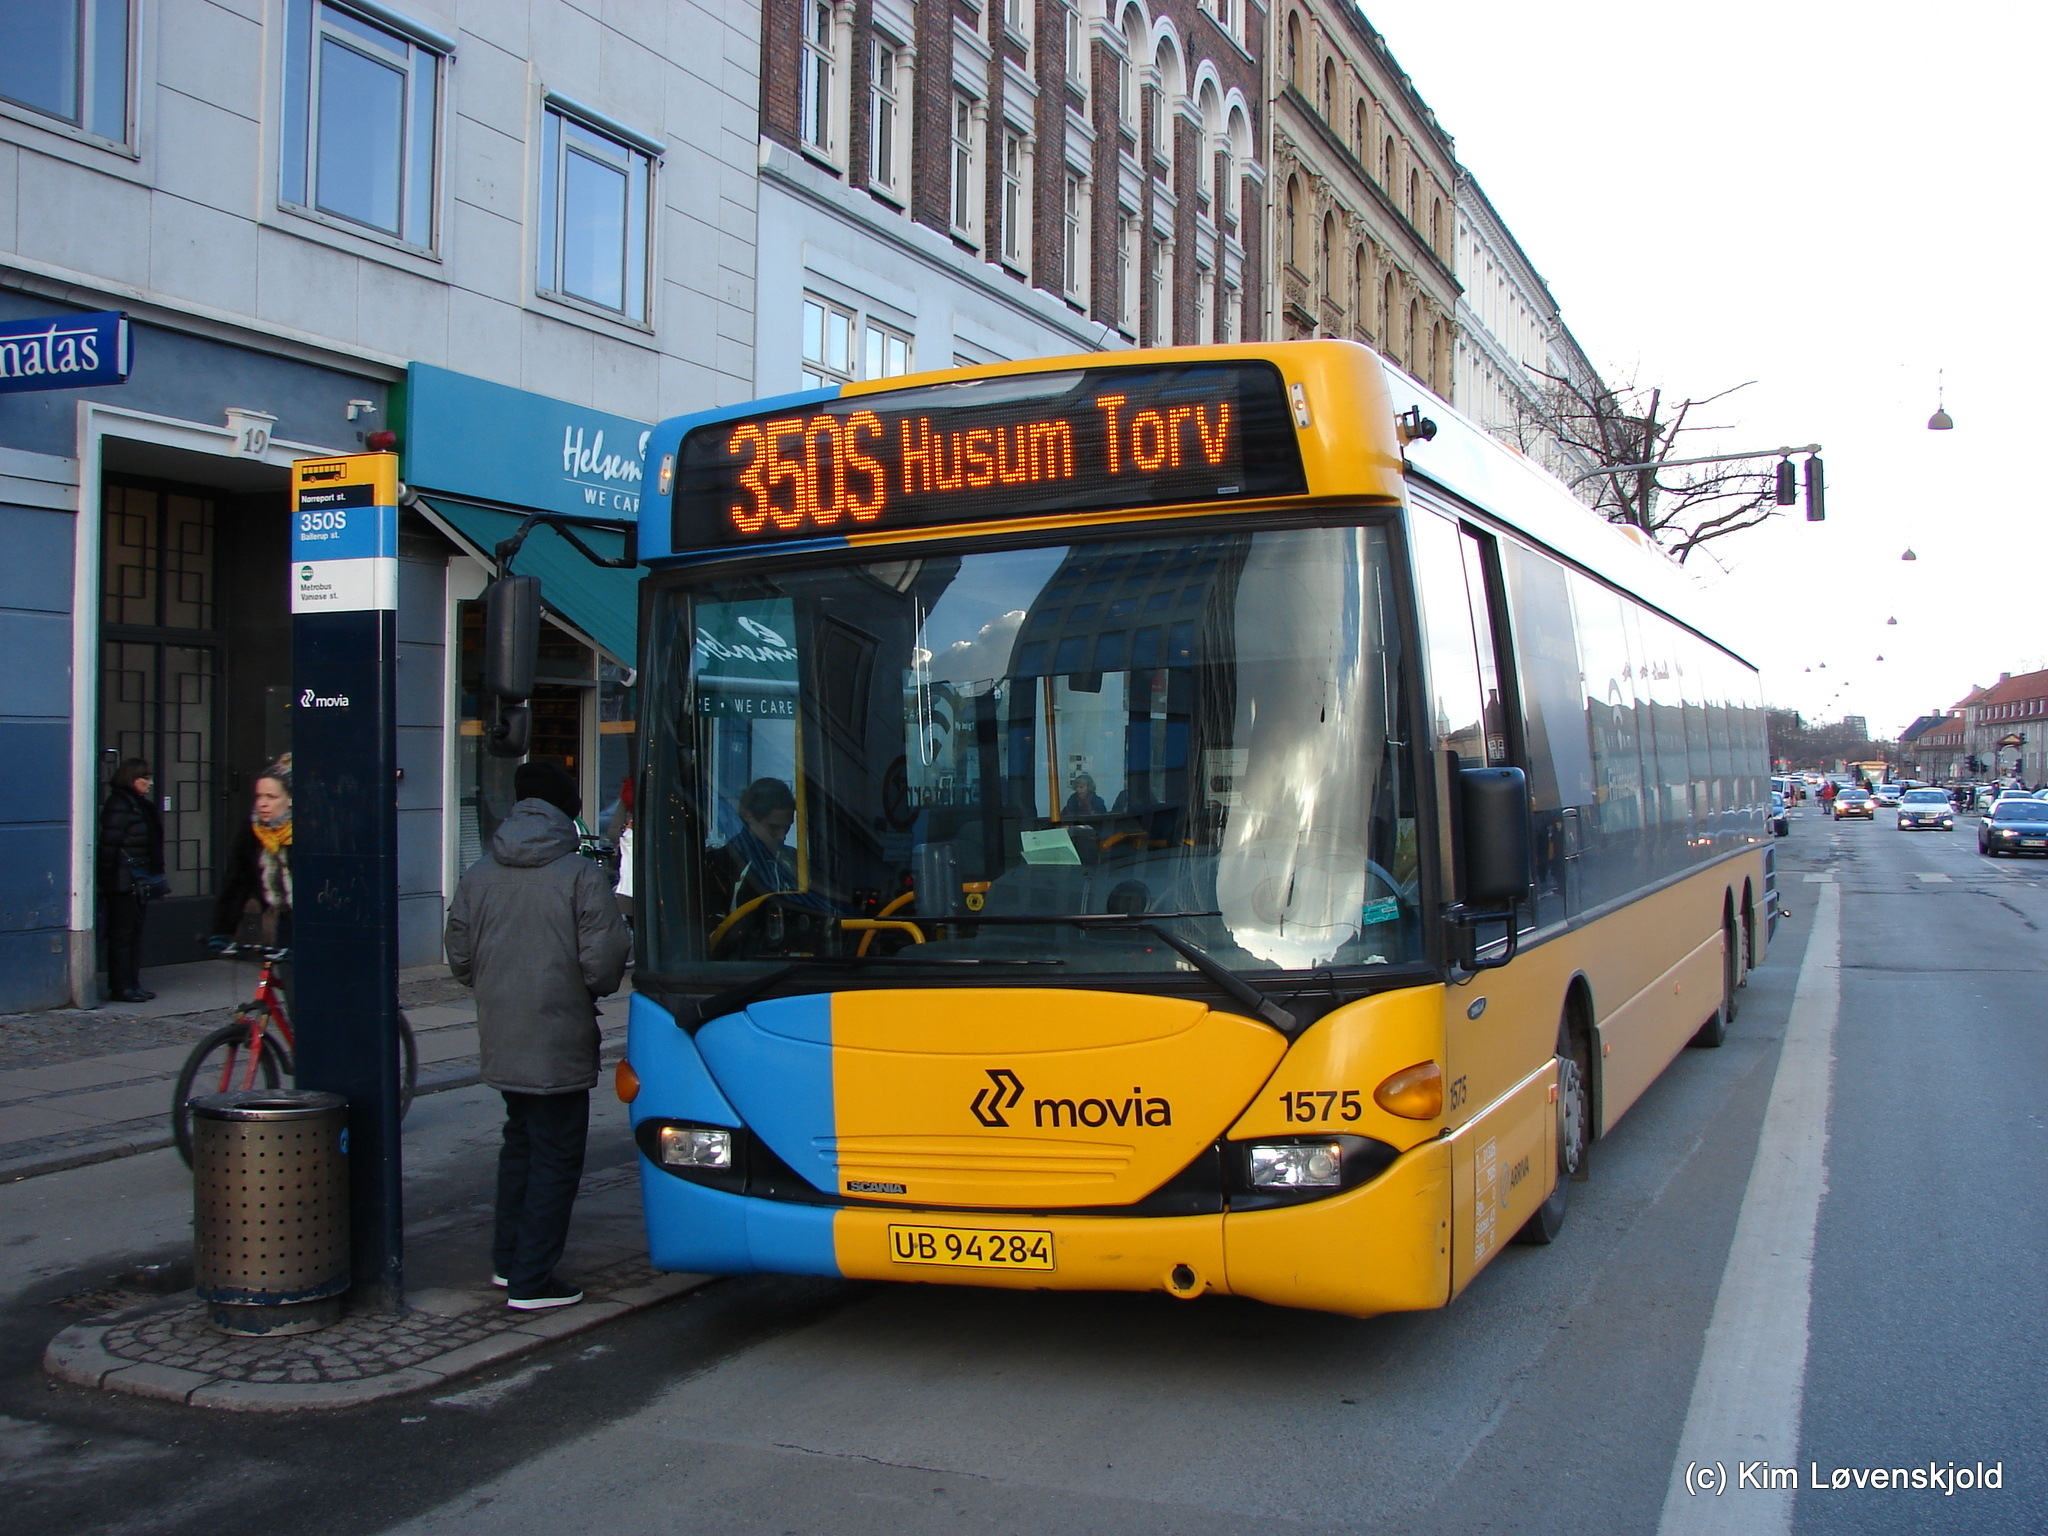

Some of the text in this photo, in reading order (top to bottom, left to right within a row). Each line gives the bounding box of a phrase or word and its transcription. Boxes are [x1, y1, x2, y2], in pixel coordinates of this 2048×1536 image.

[728, 394, 1231, 532] 350S Husum Torv
[584, 488, 606, 507] WE
[300, 510, 347, 531] 350S
[300, 532, 329, 541] Ballerup
[300, 583, 332, 591] Metrobus
[315, 694, 349, 707] movia
[734, 698, 752, 713] WE
[760, 699, 793, 714] CARE
[1033, 1086, 1172, 1128] movia
[1279, 1090, 1362, 1123] 1575
[850, 1181, 904, 1193] SCANIA
[895, 1231, 938, 1262] UB
